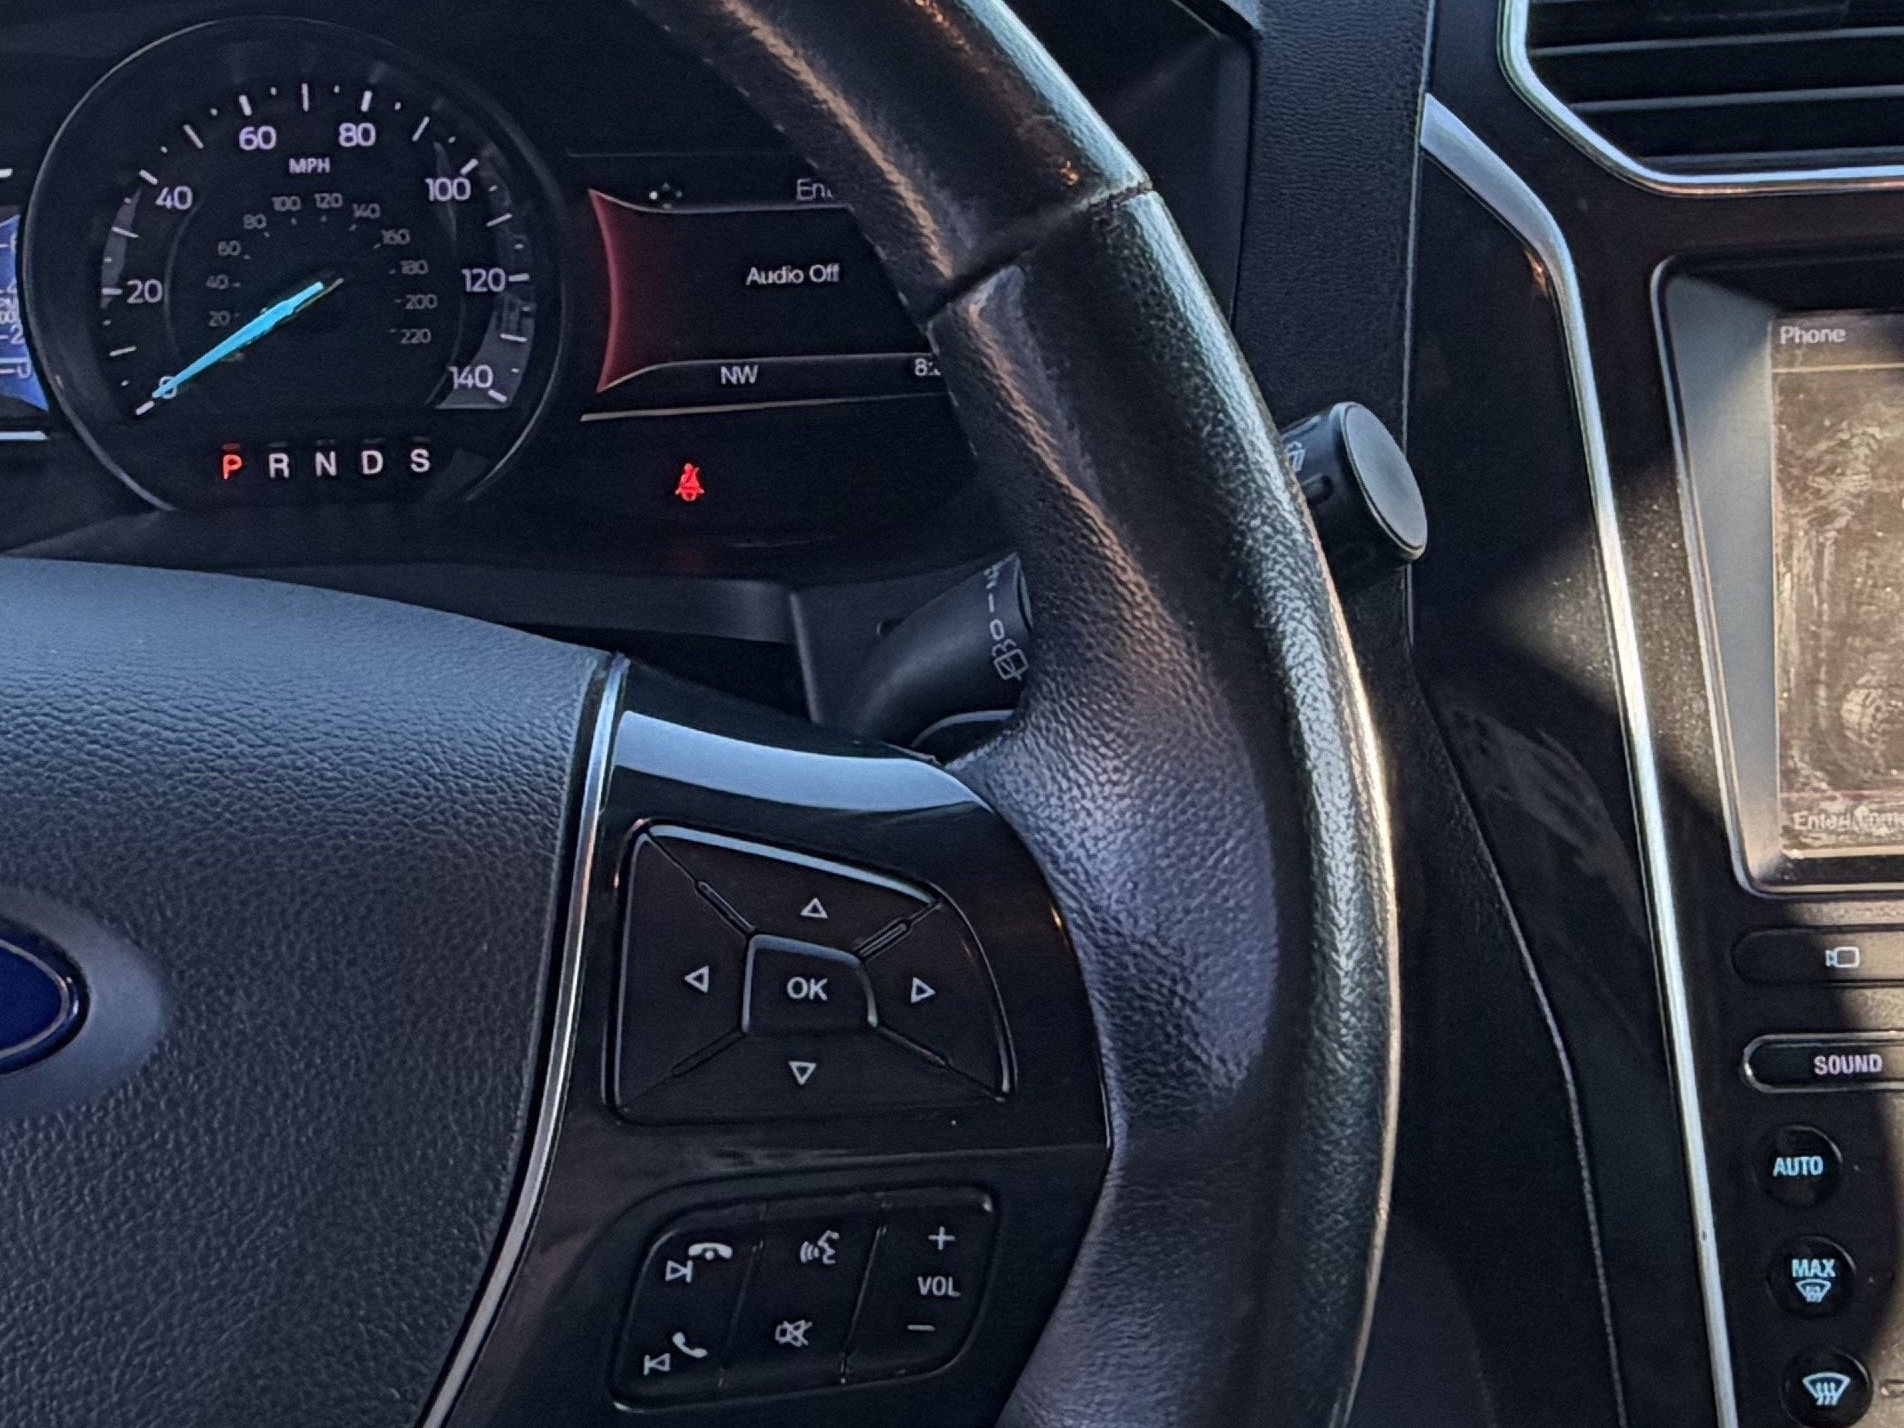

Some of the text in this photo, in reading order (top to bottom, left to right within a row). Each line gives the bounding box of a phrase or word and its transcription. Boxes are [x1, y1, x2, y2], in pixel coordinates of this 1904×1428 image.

[239, 126, 277, 151] 60
[338, 123, 377, 148] 80
[288, 157, 330, 174] MPH
[155, 186, 193, 211] 40
[425, 177, 471, 202] 100
[272, 195, 301, 212] 100
[313, 192, 344, 210] 120
[351, 202, 381, 220] 140
[242, 213, 267, 231] 80
[381, 229, 411, 246] 160
[216, 240, 242, 258] 60
[399, 259, 429, 276] 180
[745, 263, 840, 286] Audio Off
[205, 274, 230, 291] 40
[461, 268, 507, 292] 120
[126, 279, 163, 304] 20
[404, 293, 438, 311] 200
[208, 310, 231, 327] 20
[10, 324, 26, 345] 2
[399, 328, 432, 345] 220
[1779, 325, 1847, 346] Phone
[447, 365, 495, 390] 140
[720, 364, 758, 385] NW
[221, 447, 432, 481] P R N D S
[787, 976, 828, 1002] OK
[1814, 1054, 1883, 1076] SOUND
[1773, 1155, 1824, 1177] AUTO
[1792, 1258, 1836, 1278] MAX
[918, 1275, 961, 1298] VOL
